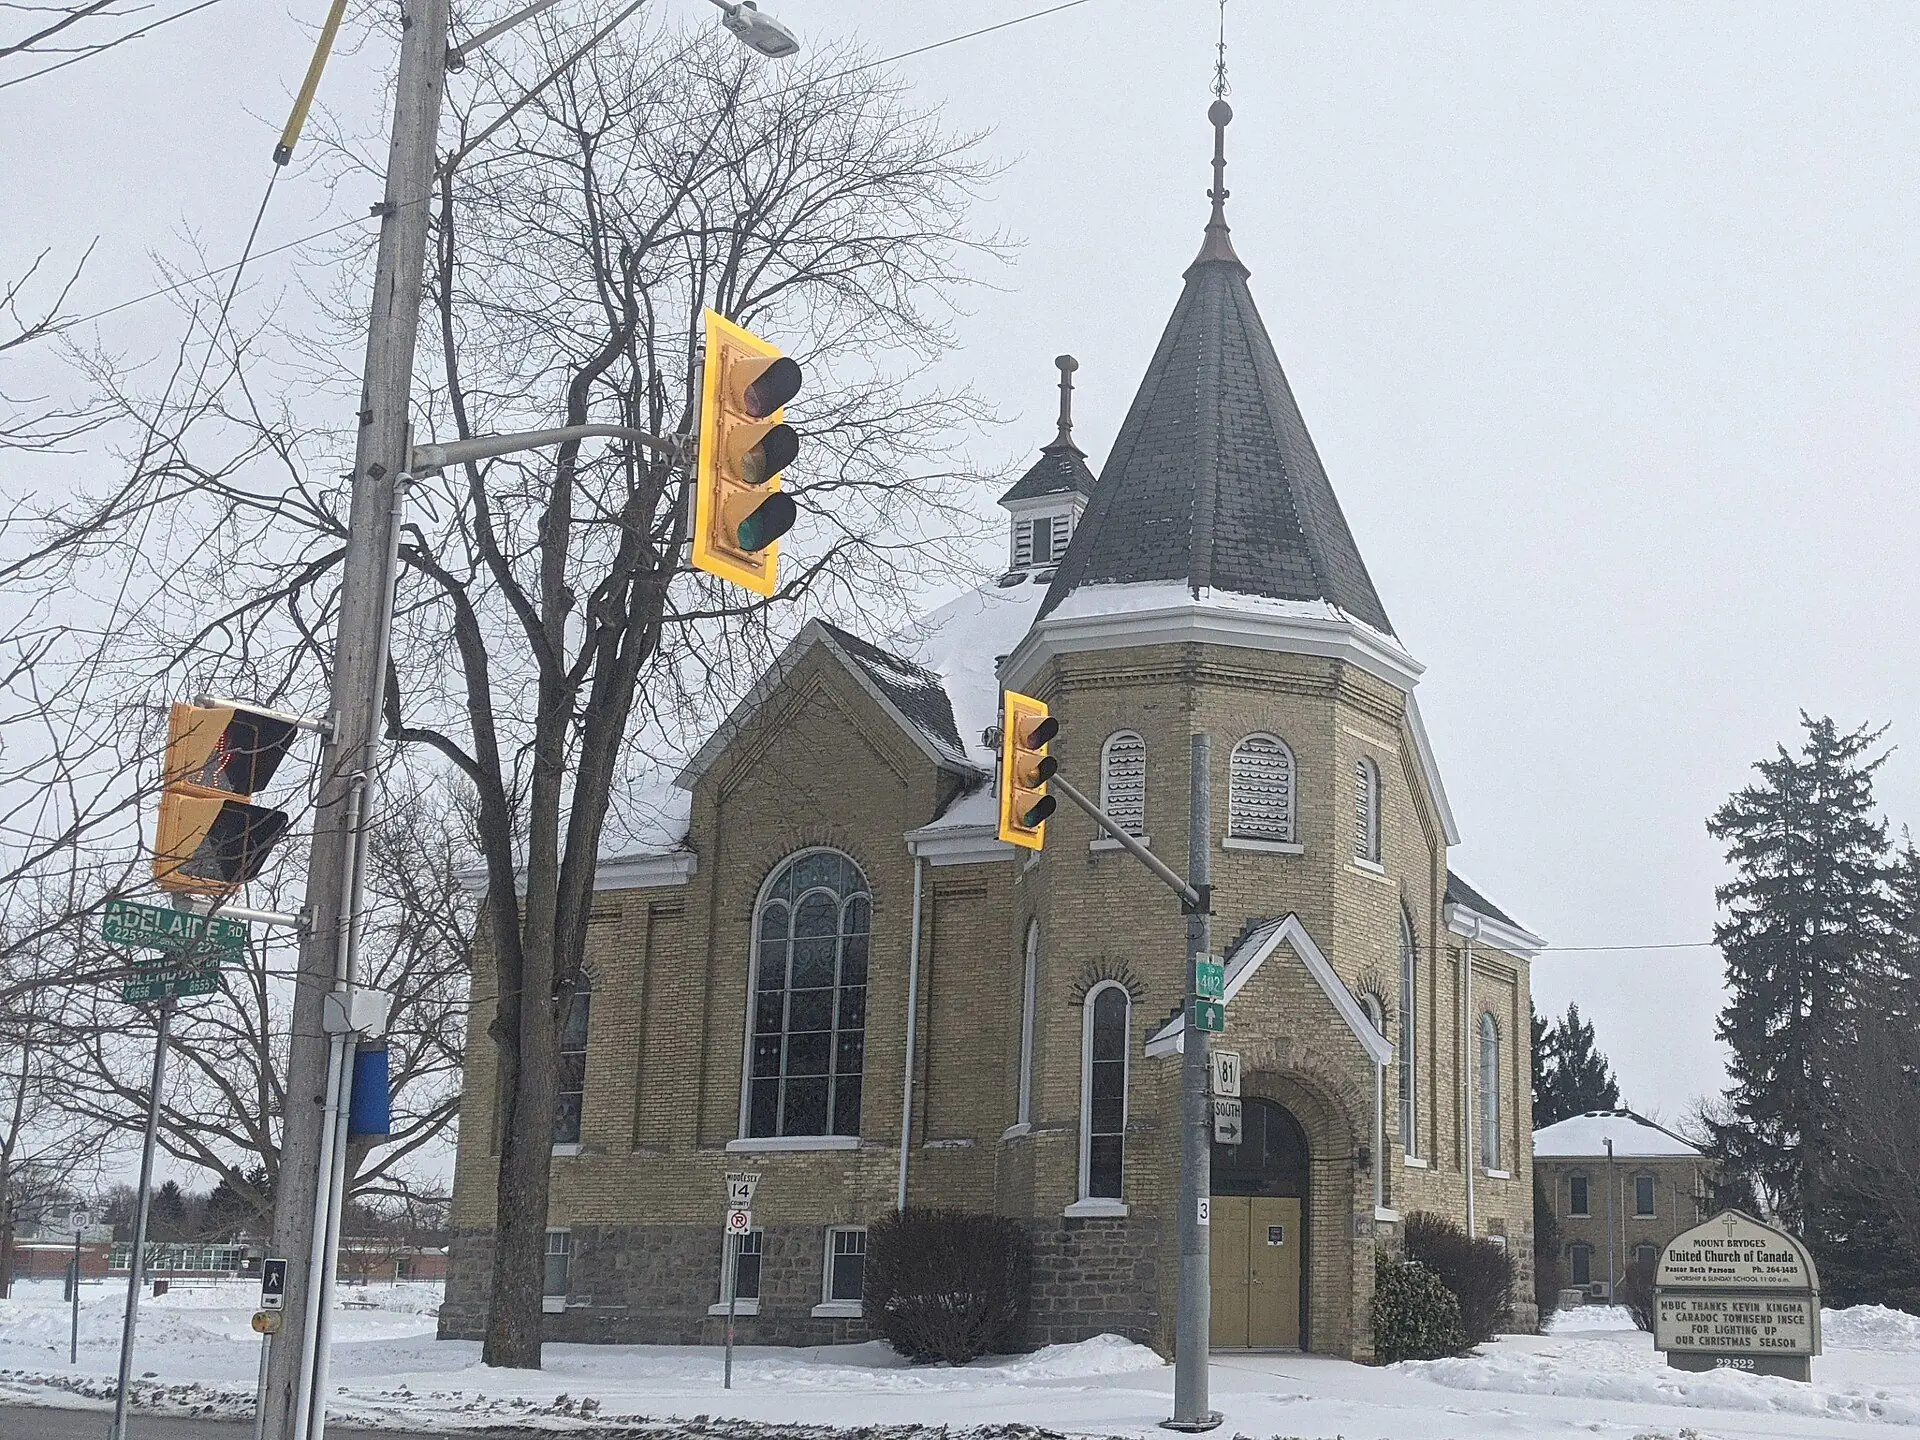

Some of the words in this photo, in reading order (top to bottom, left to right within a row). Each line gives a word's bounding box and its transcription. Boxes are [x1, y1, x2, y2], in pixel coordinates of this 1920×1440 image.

[227, 925, 244, 938] RD
[1201, 975, 1221, 992] 402
[1222, 1061, 1234, 1084] 81
[1215, 1102, 1241, 1118] SOUTH
[732, 1183, 750, 1198] 14
[1200, 1203, 1208, 1219] 3
[1693, 1239, 1724, 1248] MOUNT
[1727, 1239, 1766, 1248] BRYDGES
[1669, 1250, 1701, 1262] United
[1704, 1250, 1741, 1262] Church
[1743, 1250, 1754, 1262] of
[1757, 1251, 1794, 1263] Canada
[1708, 1266, 1736, 1274] Parsons
[1766, 1266, 1798, 1274] 264-1485
[1733, 1275, 1758, 1283] SCHOOL
[1661, 1301, 1687, 1310] MBUC
[1692, 1301, 1728, 1312] THANKS
[1732, 1302, 1760, 1312] KEVIN
[1767, 1303, 1803, 1313] KINGMA
[1661, 1313, 1668, 1321] &
[1676, 1313, 1719, 1322] CARADOC
[1723, 1314, 1773, 1324] TOWNSEND
[1777, 1316, 1805, 1325] INSCE
[1692, 1324, 1709, 1334] FOR
[1715, 1325, 1758, 1335] LIGHTING
[1764, 1326, 1777, 1335] UP
[1675, 1336, 1695, 1345] OUR
[1698, 1336, 1751, 1346] CHRISTMAS
[1759, 1337, 1796, 1348] SEASON
[1716, 1358, 1755, 1369] 22522
